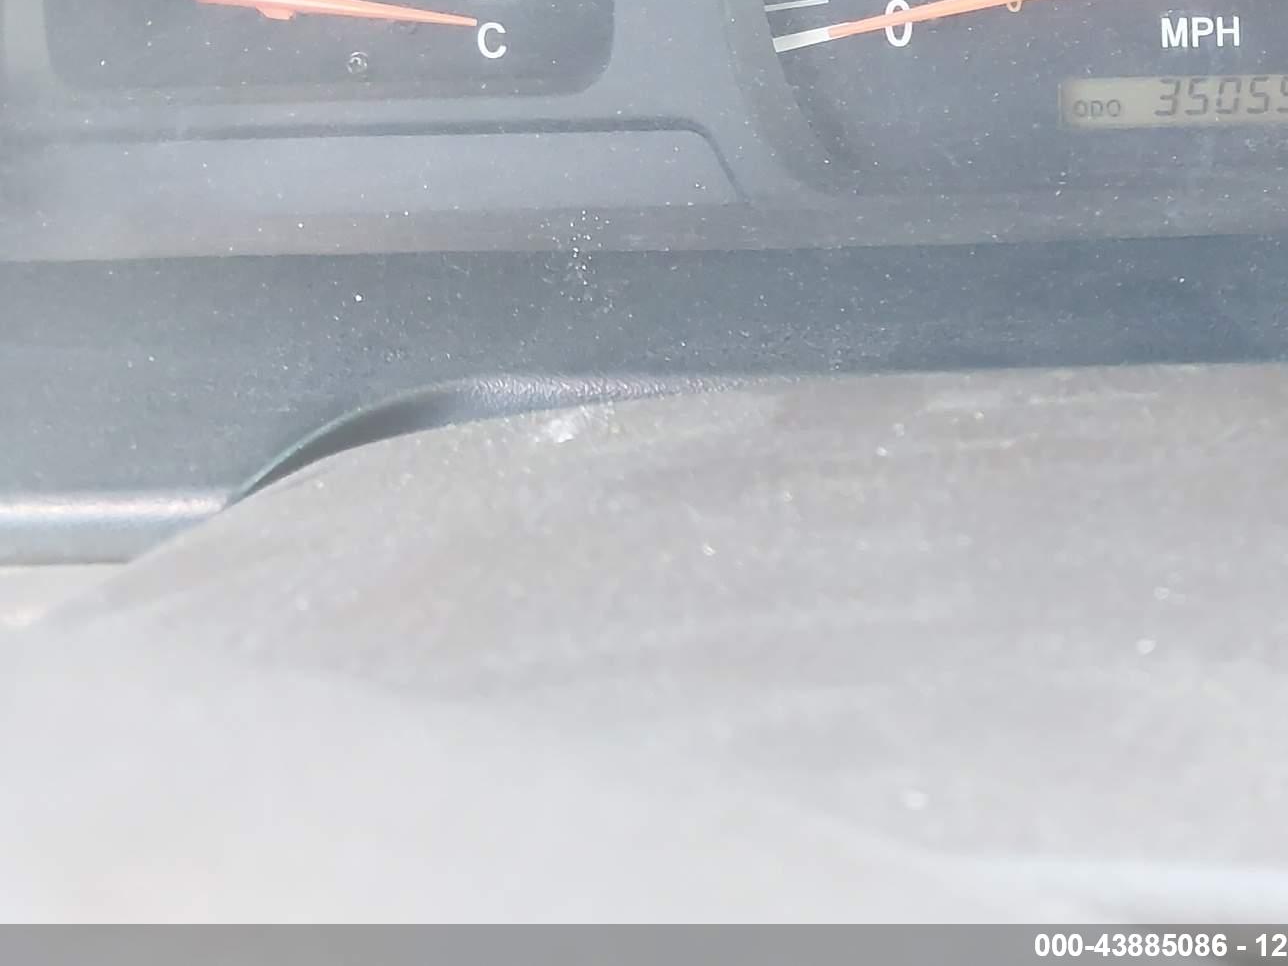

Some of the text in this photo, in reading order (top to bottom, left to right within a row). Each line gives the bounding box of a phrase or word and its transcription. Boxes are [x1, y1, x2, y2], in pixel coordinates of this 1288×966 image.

[884, 0, 913, 46] 0
[1161, 16, 1239, 47] MPH
[477, 23, 507, 59] C
[1072, 99, 1122, 118] ODO
